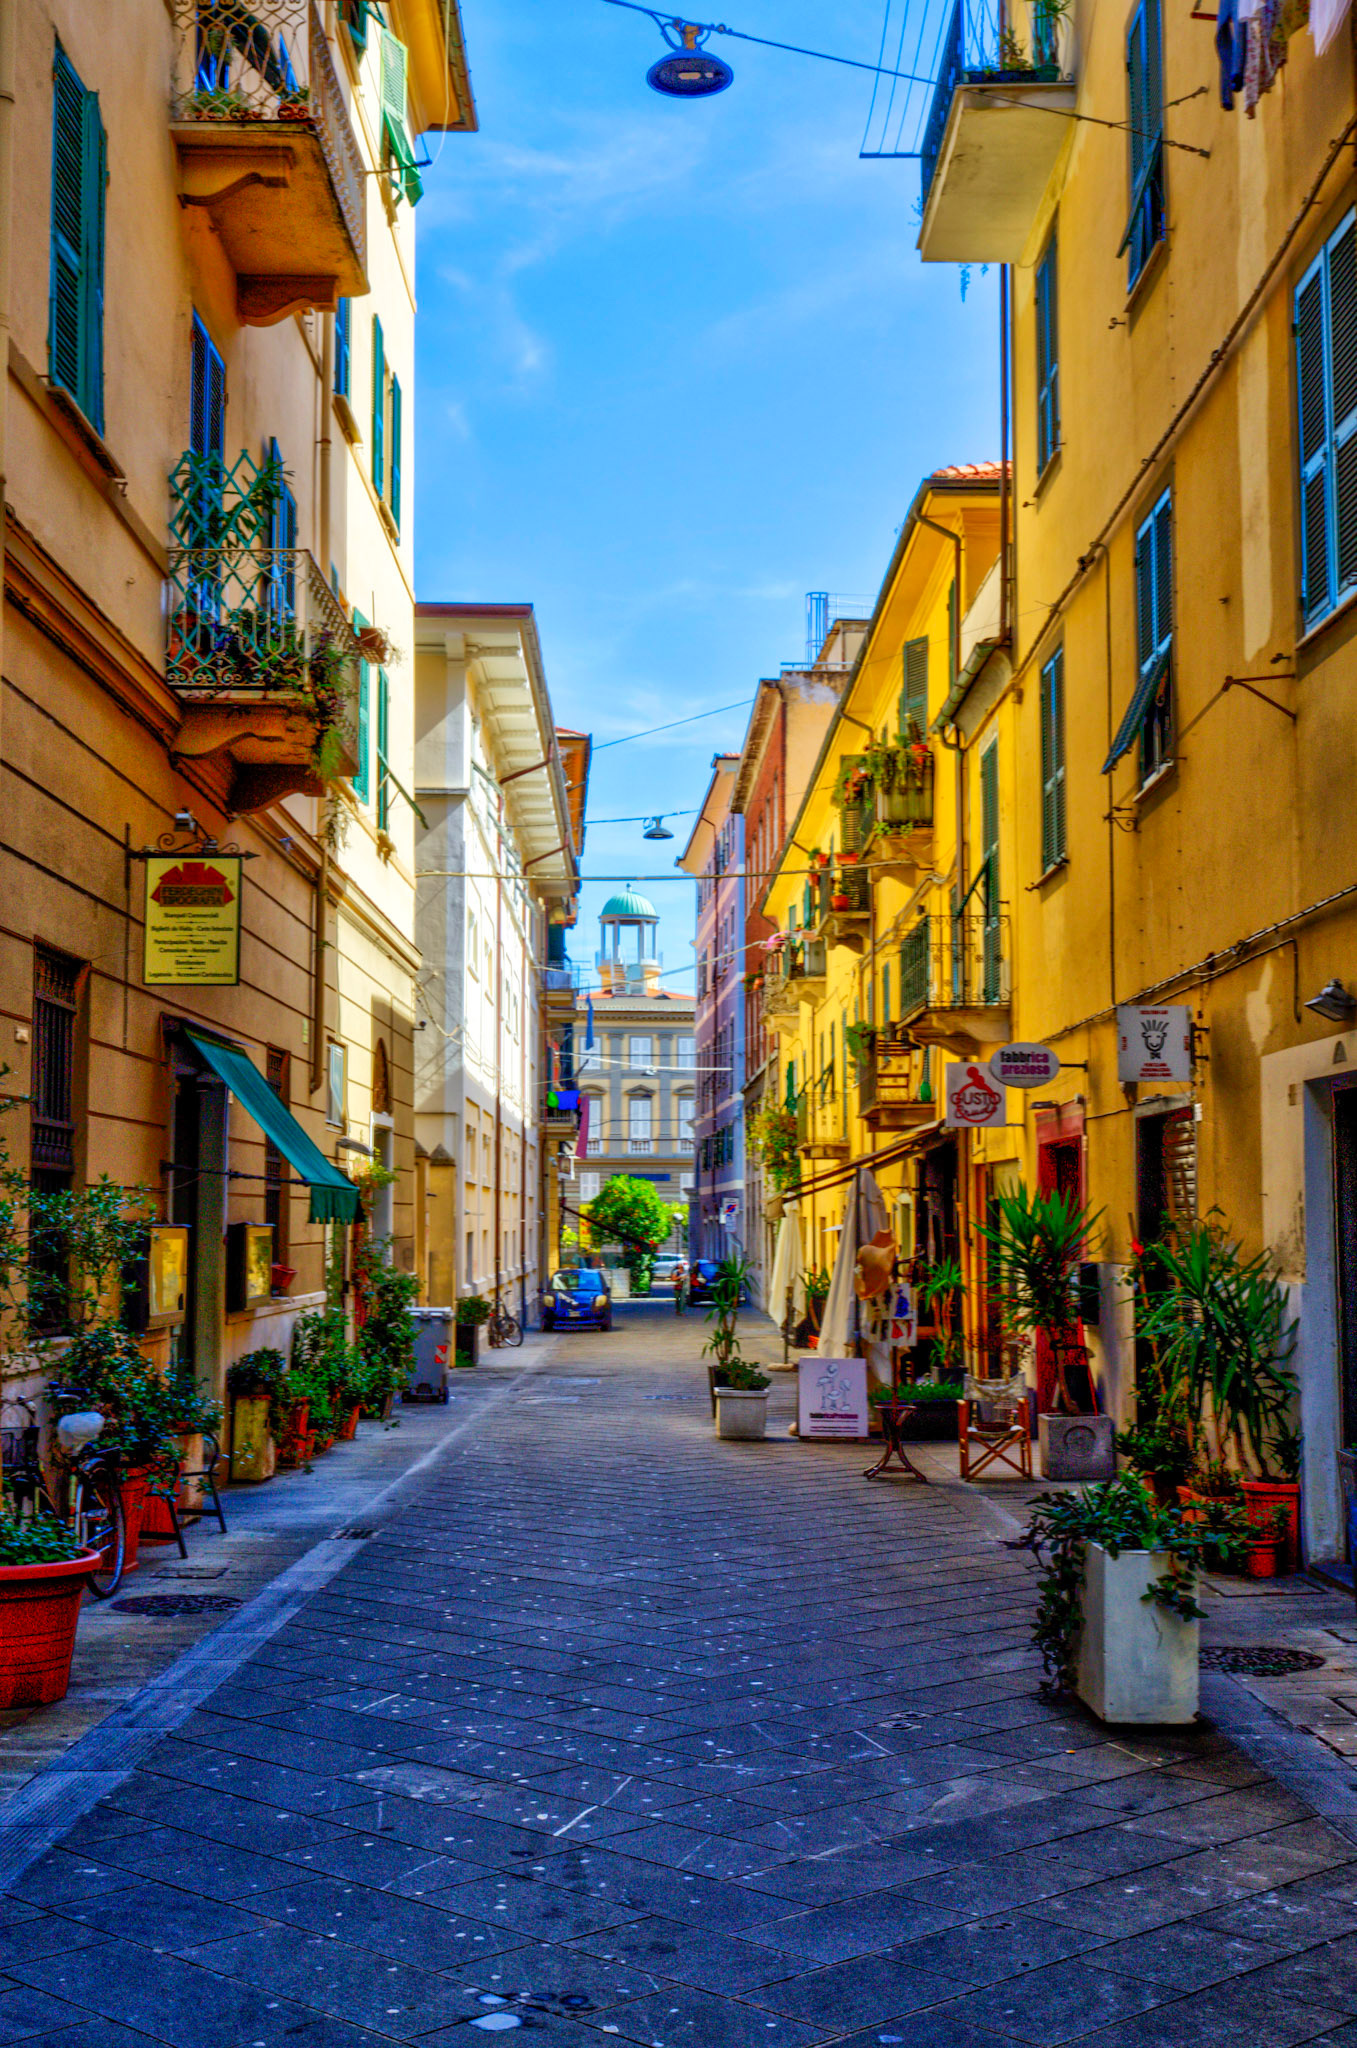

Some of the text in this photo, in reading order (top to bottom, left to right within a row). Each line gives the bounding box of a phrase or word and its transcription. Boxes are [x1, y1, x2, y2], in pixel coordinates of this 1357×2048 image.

[162, 896, 222, 905] TIPOGRAFIA
[1000, 1051, 1049, 1063] fabbrica
[950, 1092, 1002, 1105] GUSTO
